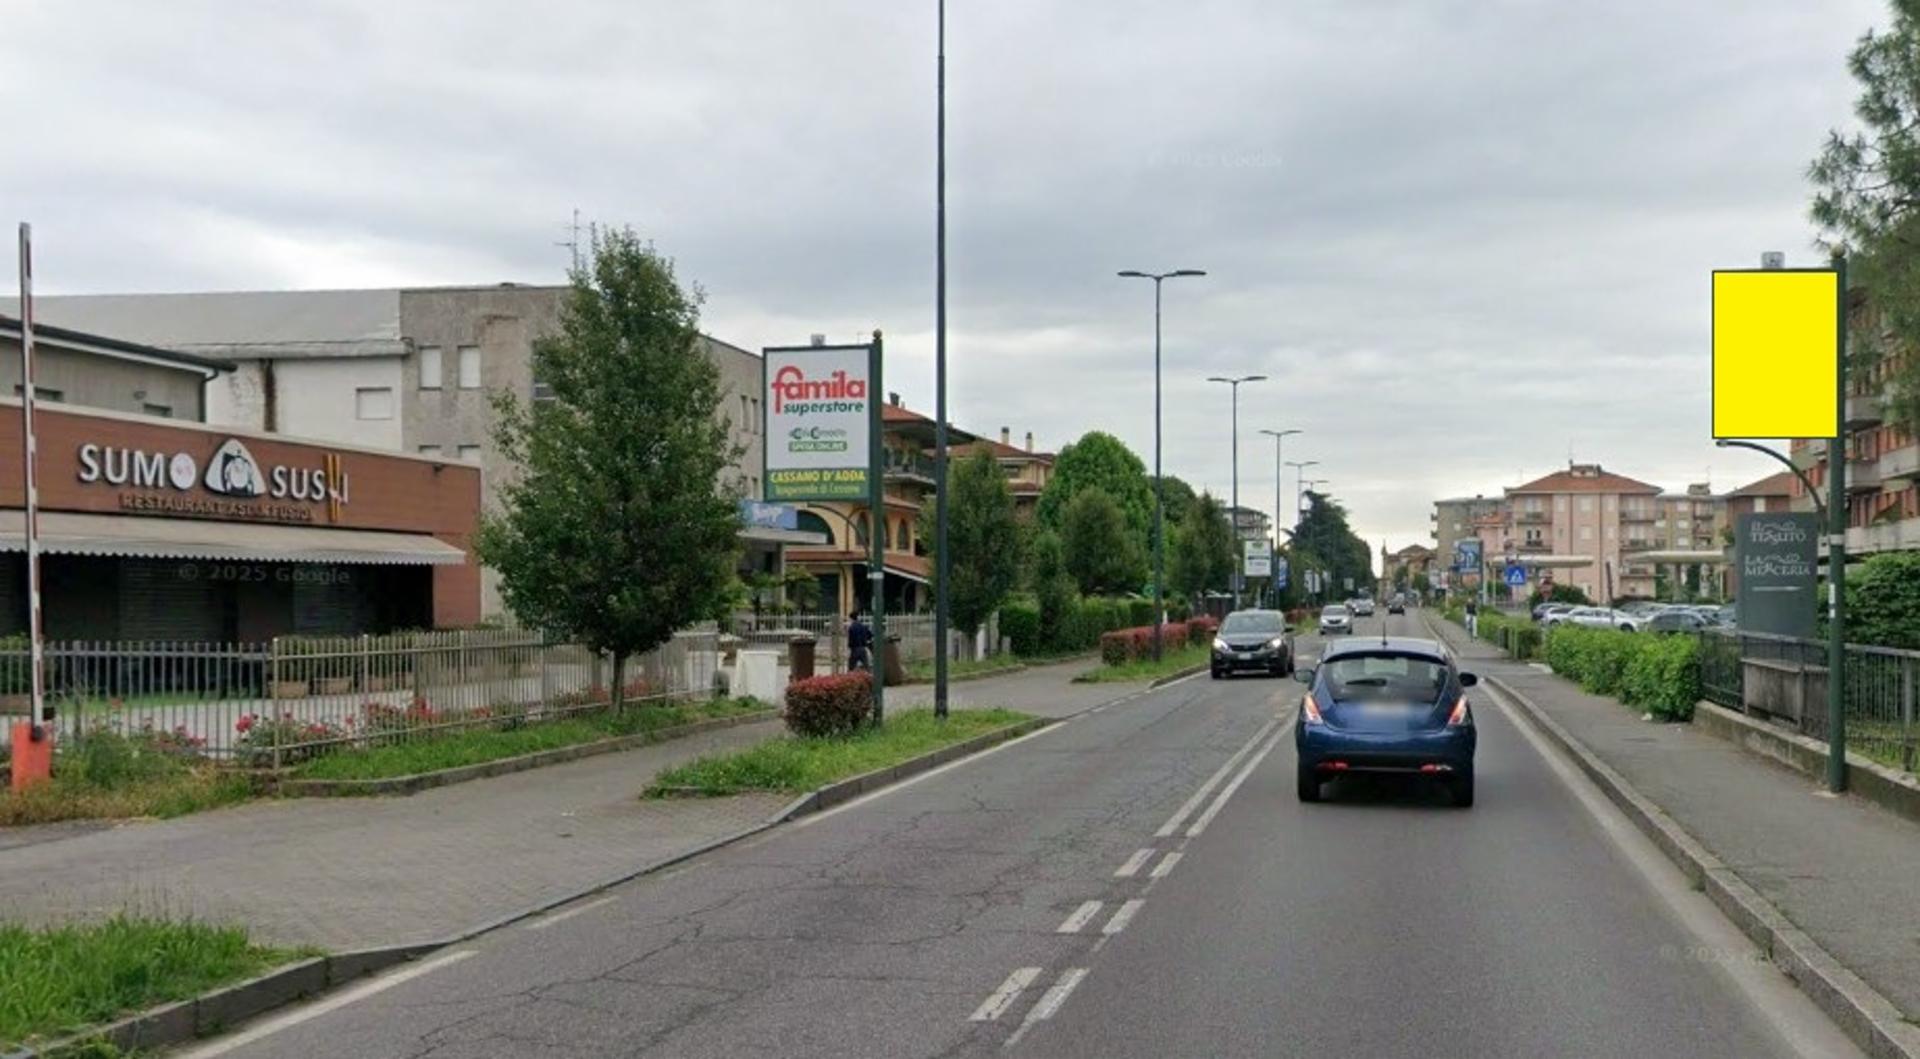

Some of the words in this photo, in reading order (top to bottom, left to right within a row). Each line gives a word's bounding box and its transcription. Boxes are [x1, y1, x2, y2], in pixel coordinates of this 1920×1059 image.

[771, 365, 865, 415] famila
[783, 401, 864, 417] superstore
[80, 443, 196, 490] SUMO
[770, 470, 820, 484] CASSANO
